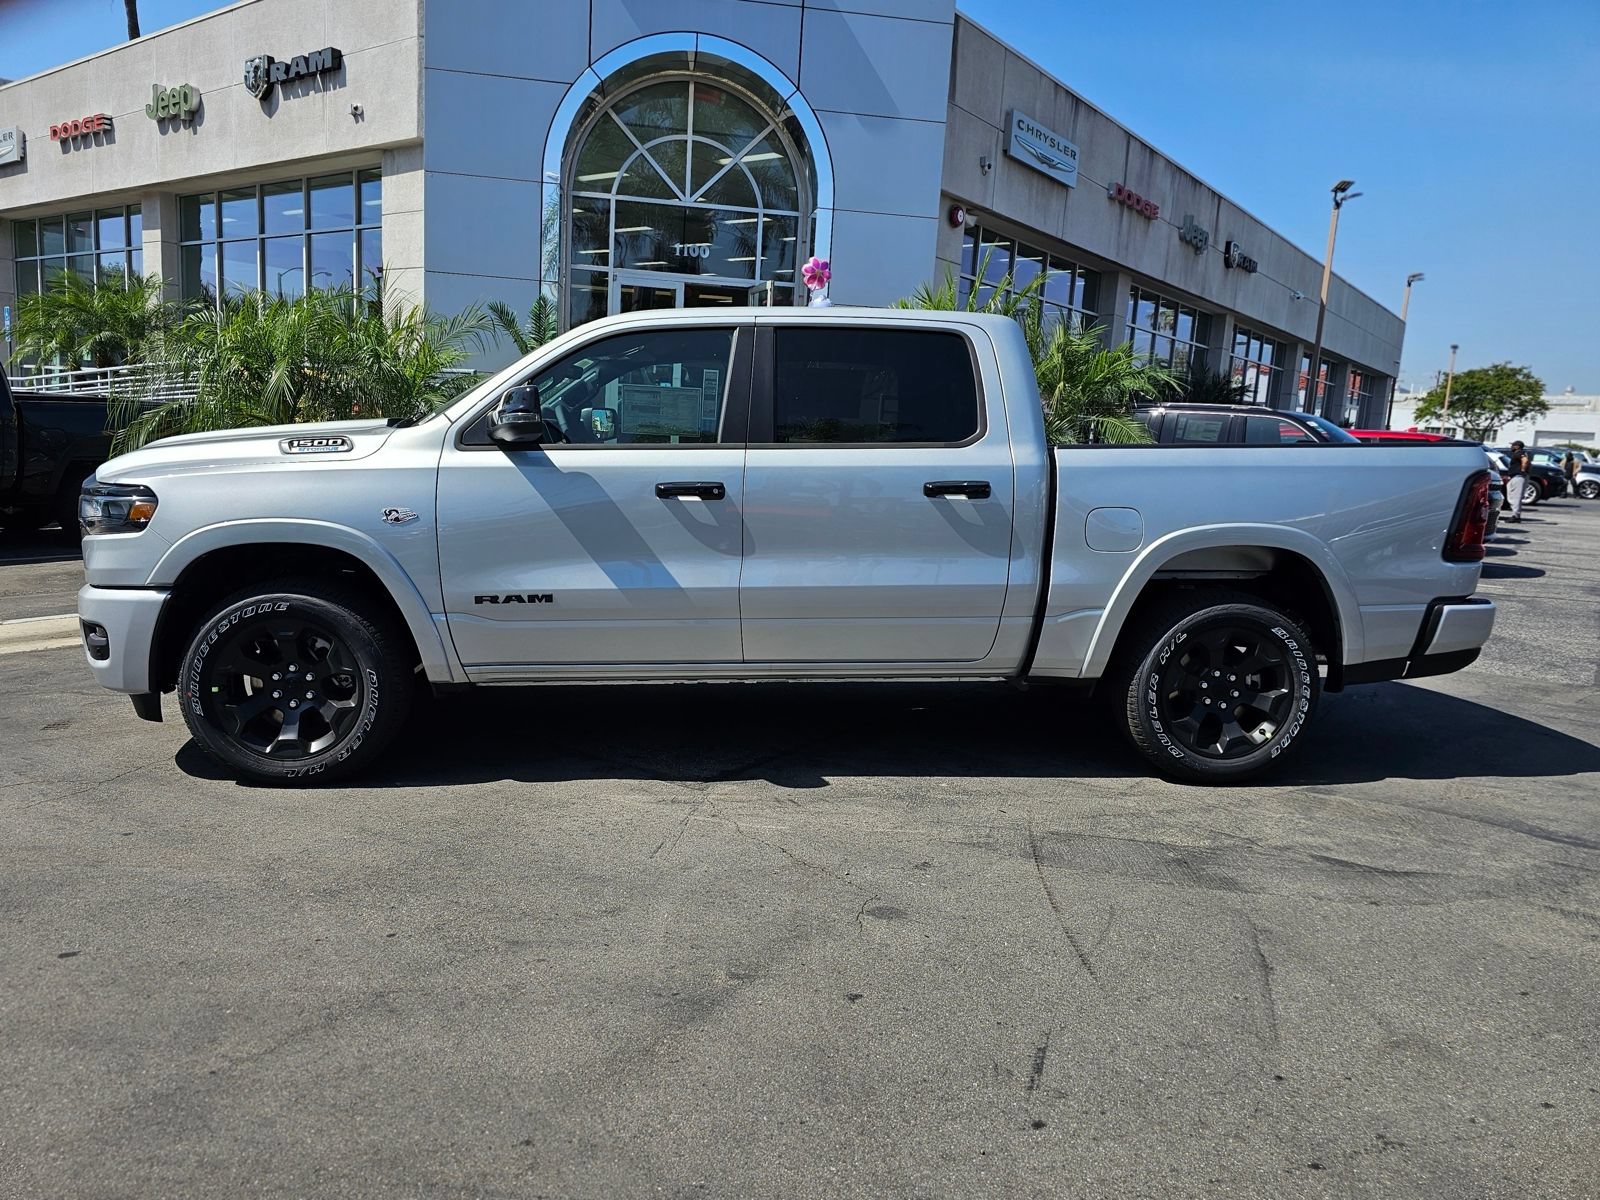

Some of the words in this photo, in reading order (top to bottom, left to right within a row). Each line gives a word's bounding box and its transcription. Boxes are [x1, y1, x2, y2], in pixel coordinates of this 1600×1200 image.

[270, 47, 342, 83] RAM
[145, 83, 200, 121] Jeep
[49, 113, 112, 141] DODGE
[1017, 119, 1077, 161] CHRYSLER
[1112, 182, 1160, 220] DODGE
[674, 243, 710, 259] 1100
[1181, 214, 1209, 255] Jeep
[1238, 252, 1258, 274] RAM
[292, 439, 343, 447] 1500
[474, 593, 553, 605] RAM
[190, 601, 290, 717] BRIDGESTONE
[1271, 626, 1311, 759] BRIDGESTONE
[336, 668, 379, 762] DUELER
[1148, 672, 1184, 758] DUELER
[283, 761, 326, 778] H/L
